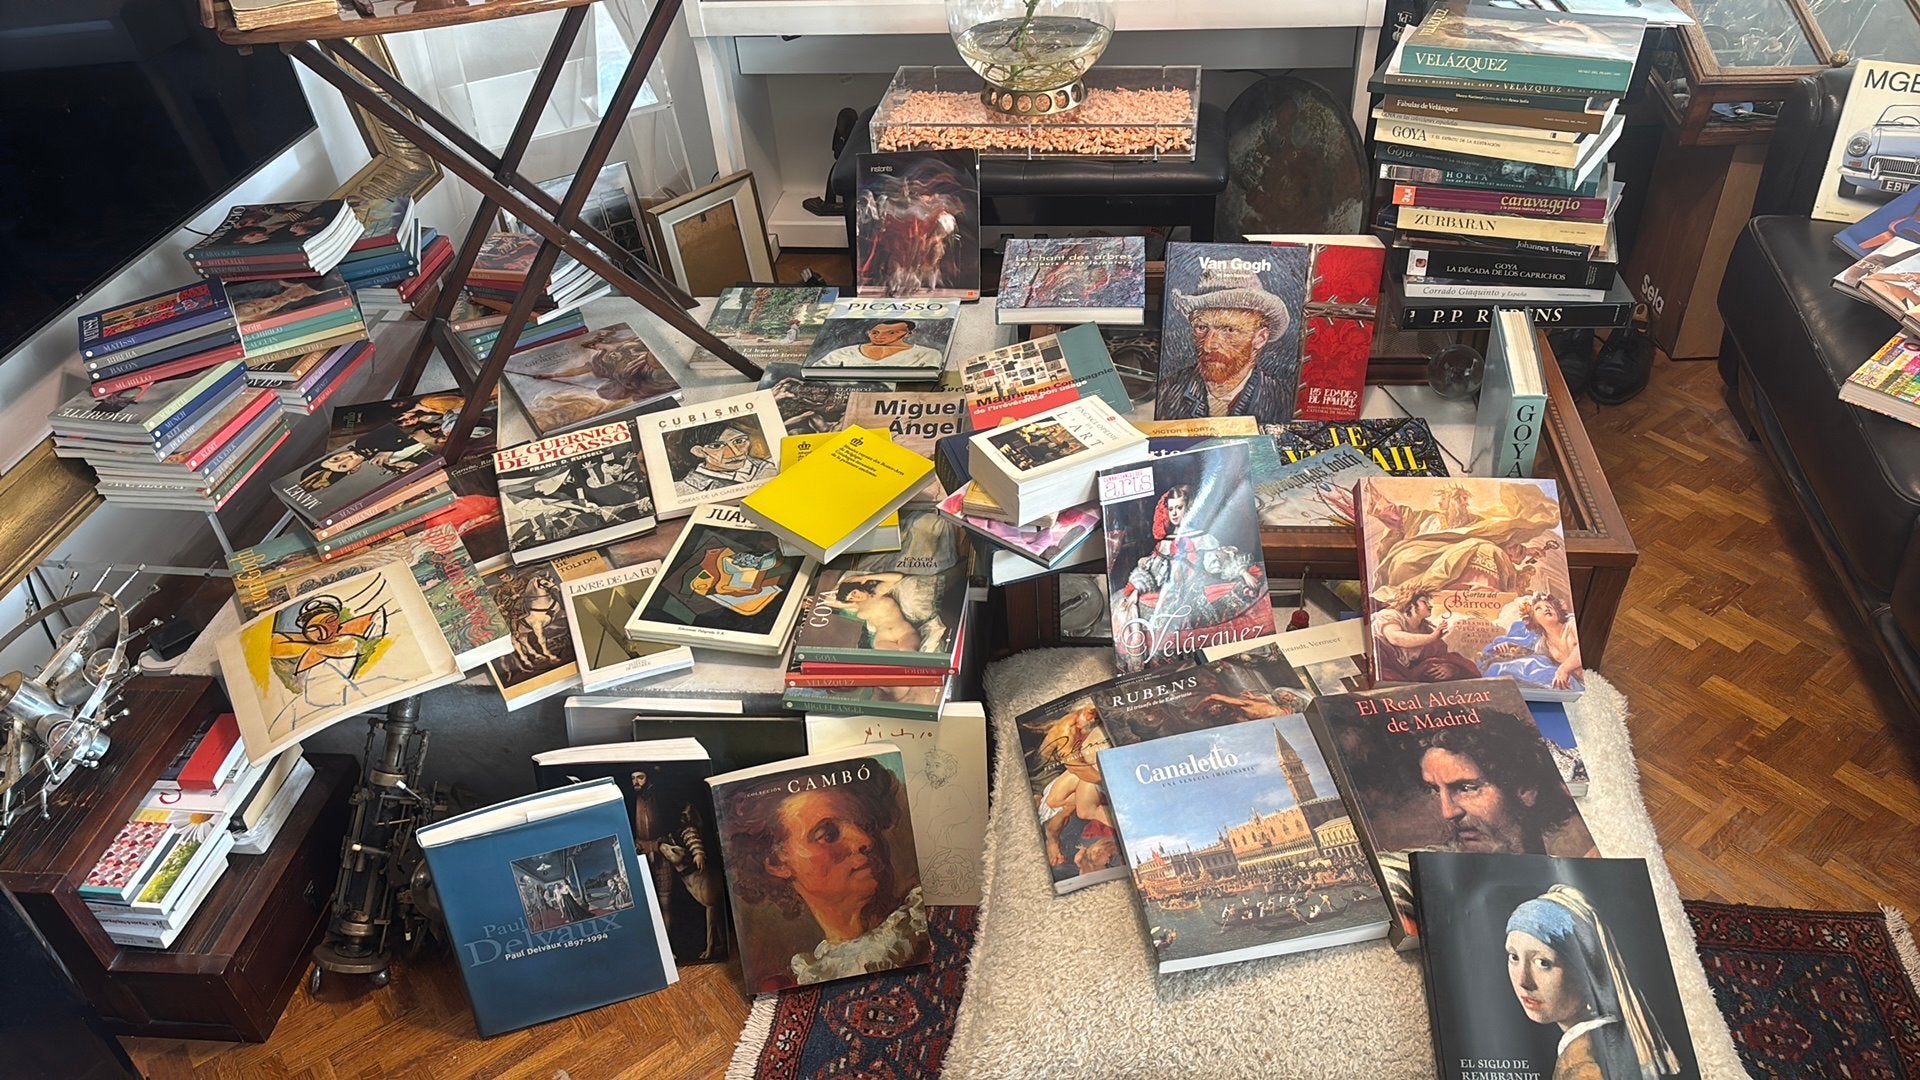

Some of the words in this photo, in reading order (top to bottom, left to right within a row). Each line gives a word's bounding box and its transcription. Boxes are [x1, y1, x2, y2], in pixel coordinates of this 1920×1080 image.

[1415, 52, 1508, 74] VELÁZQUEZ
[1503, 83, 1561, 93] VELÁZQUEZ
[1392, 125, 1427, 142] GOYA
[1387, 143, 1415, 159] Goya
[869, 165, 893, 173] instants
[1885, 181, 1911, 192] EBW
[1500, 195, 1581, 215] caravaggio
[1094, 253, 1133, 261] arbres
[1515, 239, 1549, 253] Johannes
[1549, 245, 1583, 258] Vermeer
[1199, 256, 1228, 271] Van
[1231, 257, 1271, 274] Gogh
[1458, 266, 1490, 275] DÉCADA
[1492, 269, 1503, 277] DE
[1503, 270, 1519, 278] LOS
[1519, 271, 1566, 281] CAPRICHOS
[1495, 262, 1518, 271] GOYA
[1422, 286, 1456, 297] Corrado
[1458, 286, 1500, 298] Giaquinto
[1507, 290, 1528, 298] España
[846, 301, 944, 312] PICASSO
[103, 336, 138, 353] MATISSE
[106, 349, 139, 364] RIBERA
[109, 360, 139, 375] BACON
[115, 374, 153, 390] MURILLO
[1039, 387, 1058, 397] bon
[1059, 379, 1088, 391] usage
[976, 390, 1032, 408] Magritte
[1033, 385, 1051, 396] en
[57, 407, 139, 424] MAGRITTE
[658, 402, 755, 429] CUBISMO
[873, 399, 966, 420] Miguel
[973, 407, 986, 415] de
[165, 410, 187, 429] MUNCH
[888, 416, 962, 439] Ángel
[170, 425, 196, 450] DUCHAMP
[497, 449, 523, 461] EL
[526, 422, 628, 455] GUERNICA
[1327, 426, 1368, 447] LE
[1506, 403, 1537, 478] GOYA
[200, 442, 219, 459] KLIMT
[498, 456, 531, 471] DE
[538, 431, 631, 462] PICASSO
[529, 463, 557, 472] FRANK
[570, 450, 605, 462] RUSSELL
[711, 489, 721, 498] LA
[1104, 473, 1153, 499] arts
[282, 484, 323, 510] MANET
[336, 506, 382, 532] REMBRANDT
[339, 501, 366, 519] MANET
[338, 529, 370, 546] HOPPER
[229, 548, 267, 587] Gogh
[555, 562, 570, 570] DE
[560, 556, 598, 573] TOLEDO
[896, 560, 938, 569] ZULOAGA
[569, 580, 605, 595] LIVRE
[606, 574, 623, 586] DE
[624, 570, 640, 581] LA
[809, 589, 839, 628] GOYA
[1443, 592, 1501, 614] Barroco
[1121, 605, 1264, 664] Velázquez
[1309, 637, 1343, 648] Vermeer
[815, 654, 838, 662] GOYA
[806, 679, 856, 687] VELÁZQUEZ
[1112, 676, 1198, 708] RUBENS
[803, 702, 835, 713] MIGUEL
[1134, 701, 1152, 710] triunfo
[1354, 699, 1380, 717] El
[1384, 694, 1423, 713] Real
[1427, 687, 1492, 708] Alcázar
[1386, 717, 1411, 734] de
[1413, 708, 1481, 730] Madrid
[1135, 743, 1239, 785] Canaletto
[1212, 765, 1256, 778] IMAGINARIA
[786, 763, 872, 795] CAMBÓ
[482, 916, 529, 940] Paul
[463, 913, 624, 968] Delvaux
[504, 949, 526, 961] Paul
[526, 940, 562, 956] Delvaux
[563, 933, 609, 949] 1897-1994
[1460, 1058, 1476, 1068] EL
[1477, 1059, 1511, 1070] SIGLO
[1513, 1059, 1530, 1069] DE
[1461, 1071, 1541, 1080] REMBRANDT
